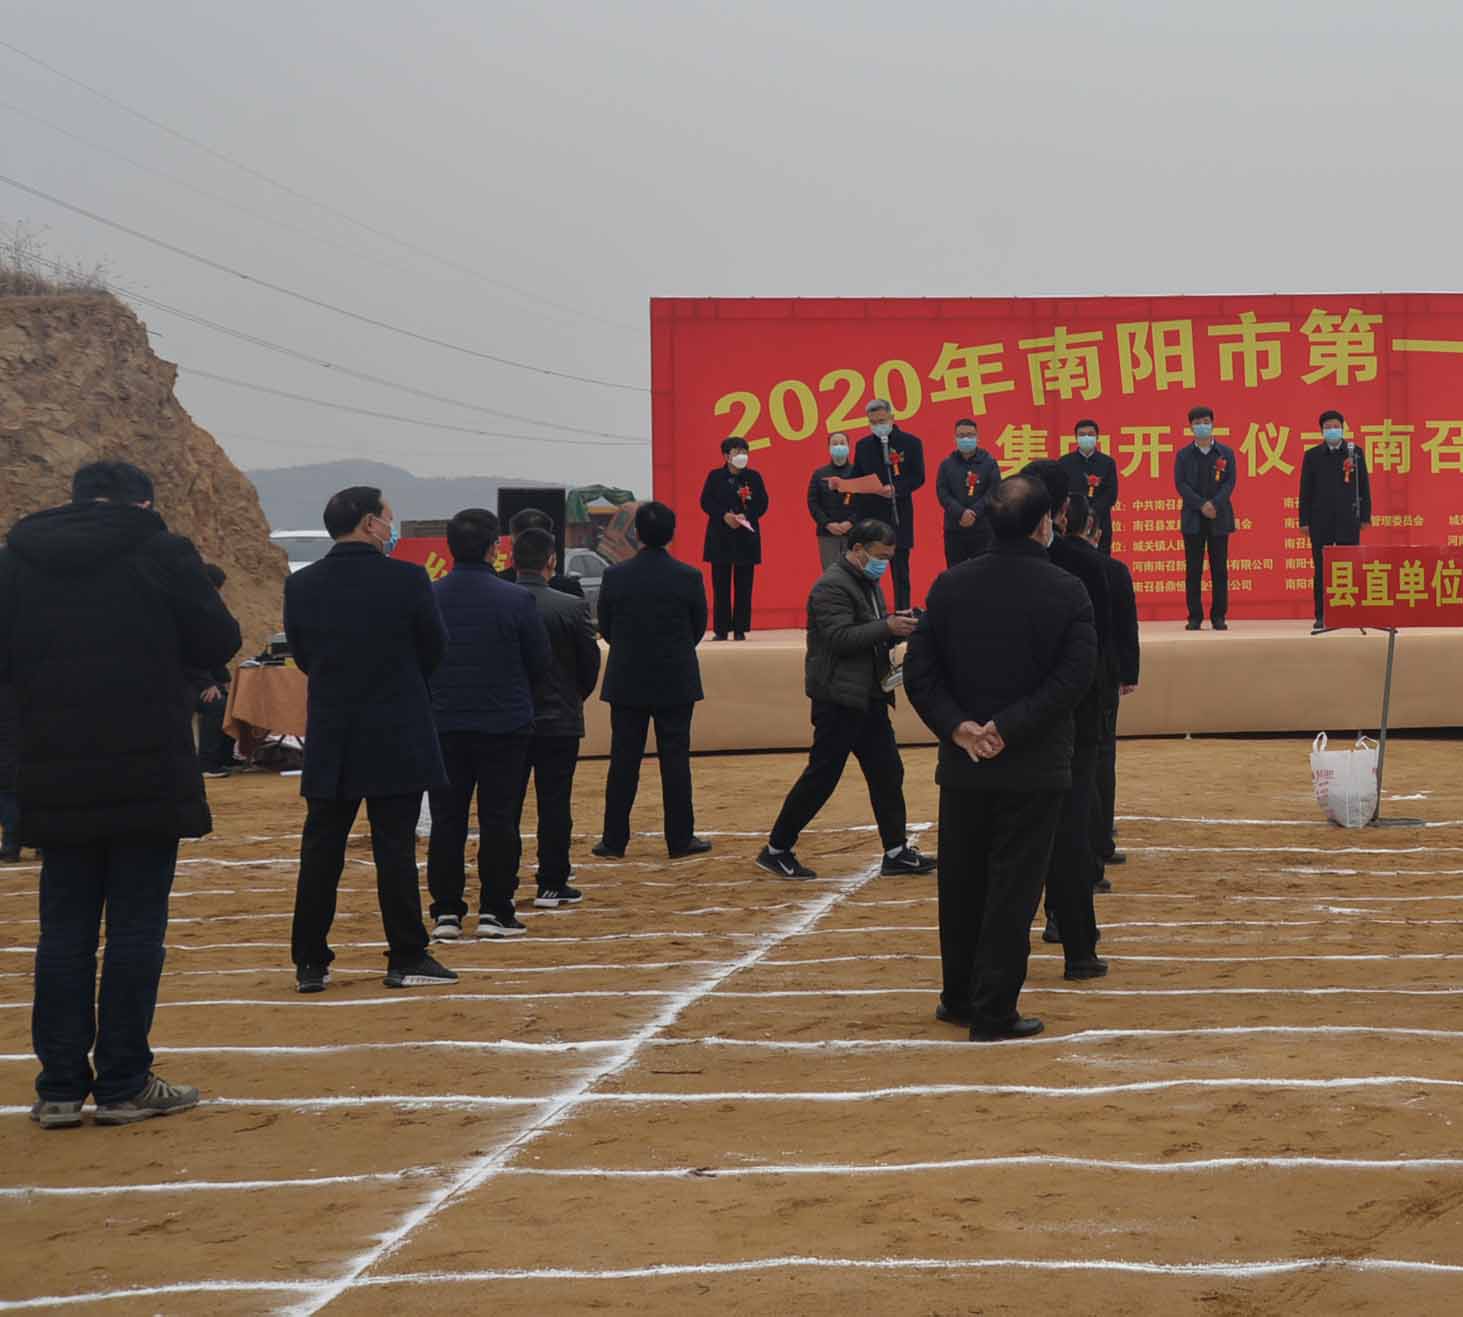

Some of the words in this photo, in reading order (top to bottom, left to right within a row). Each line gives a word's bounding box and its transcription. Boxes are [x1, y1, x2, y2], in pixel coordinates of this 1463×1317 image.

[1227, 558, 1273, 570] 有限公司
[1326, 560, 1463, 608] 县直单位
